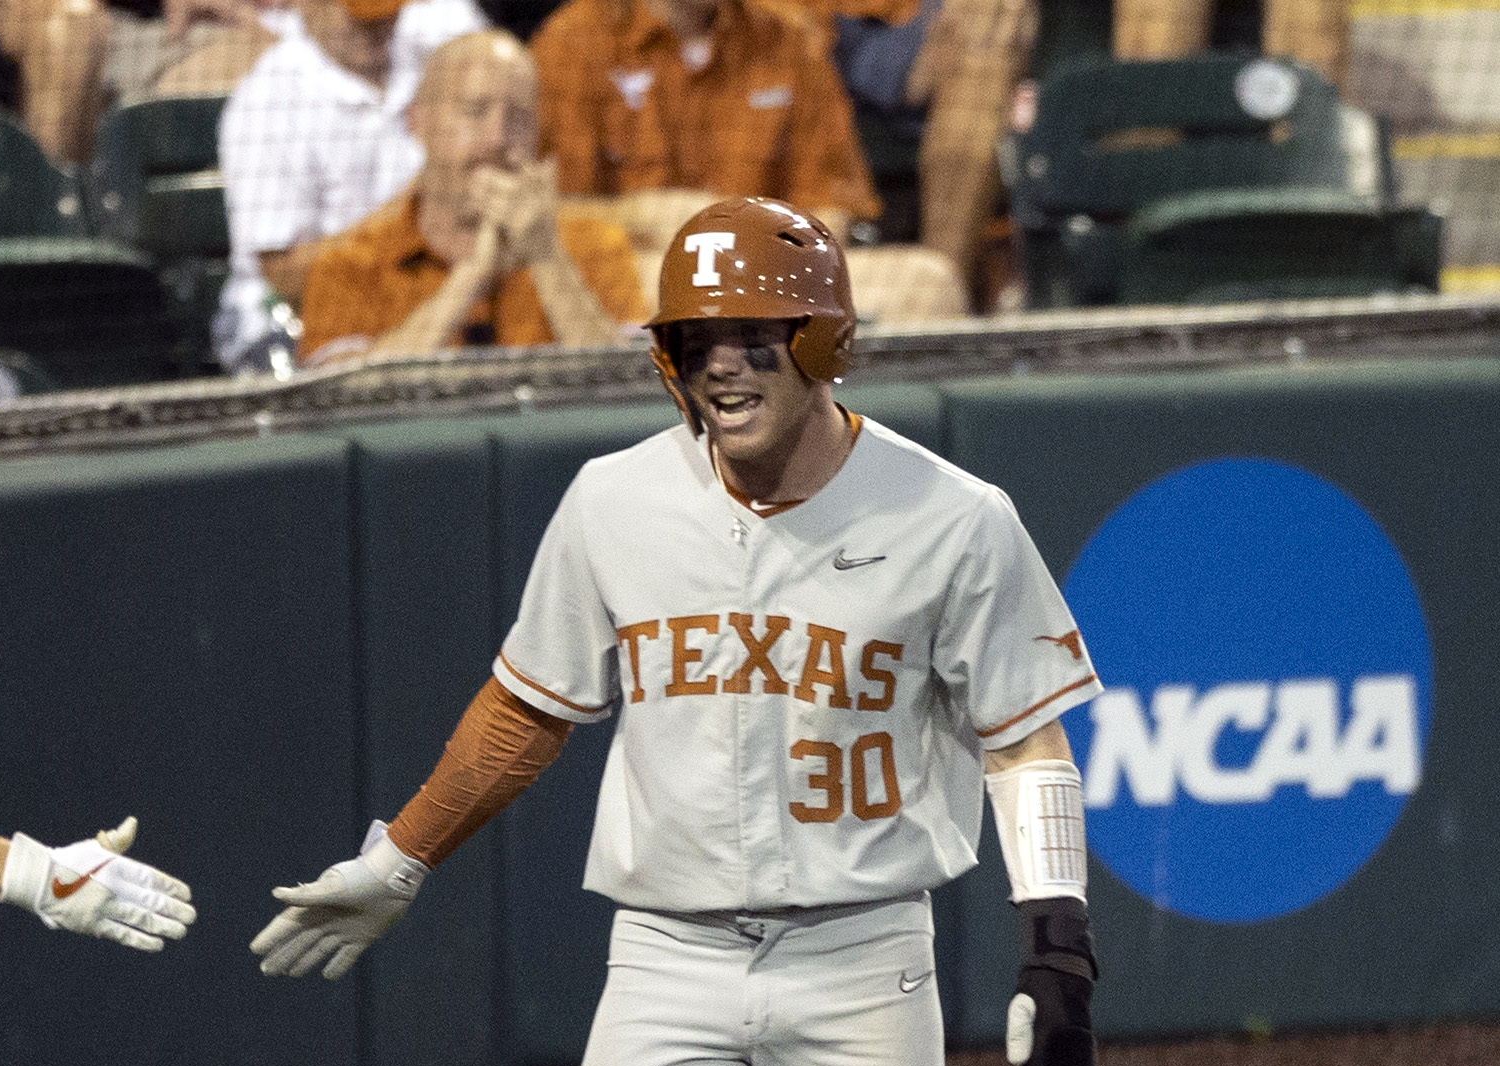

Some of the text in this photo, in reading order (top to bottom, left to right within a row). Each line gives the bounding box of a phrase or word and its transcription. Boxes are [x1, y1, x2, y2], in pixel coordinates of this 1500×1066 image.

[684, 231, 737, 288] T
[616, 612, 904, 712] TEXAS
[789, 731, 902, 823] 30
[1084, 672, 1421, 808] NCAA
